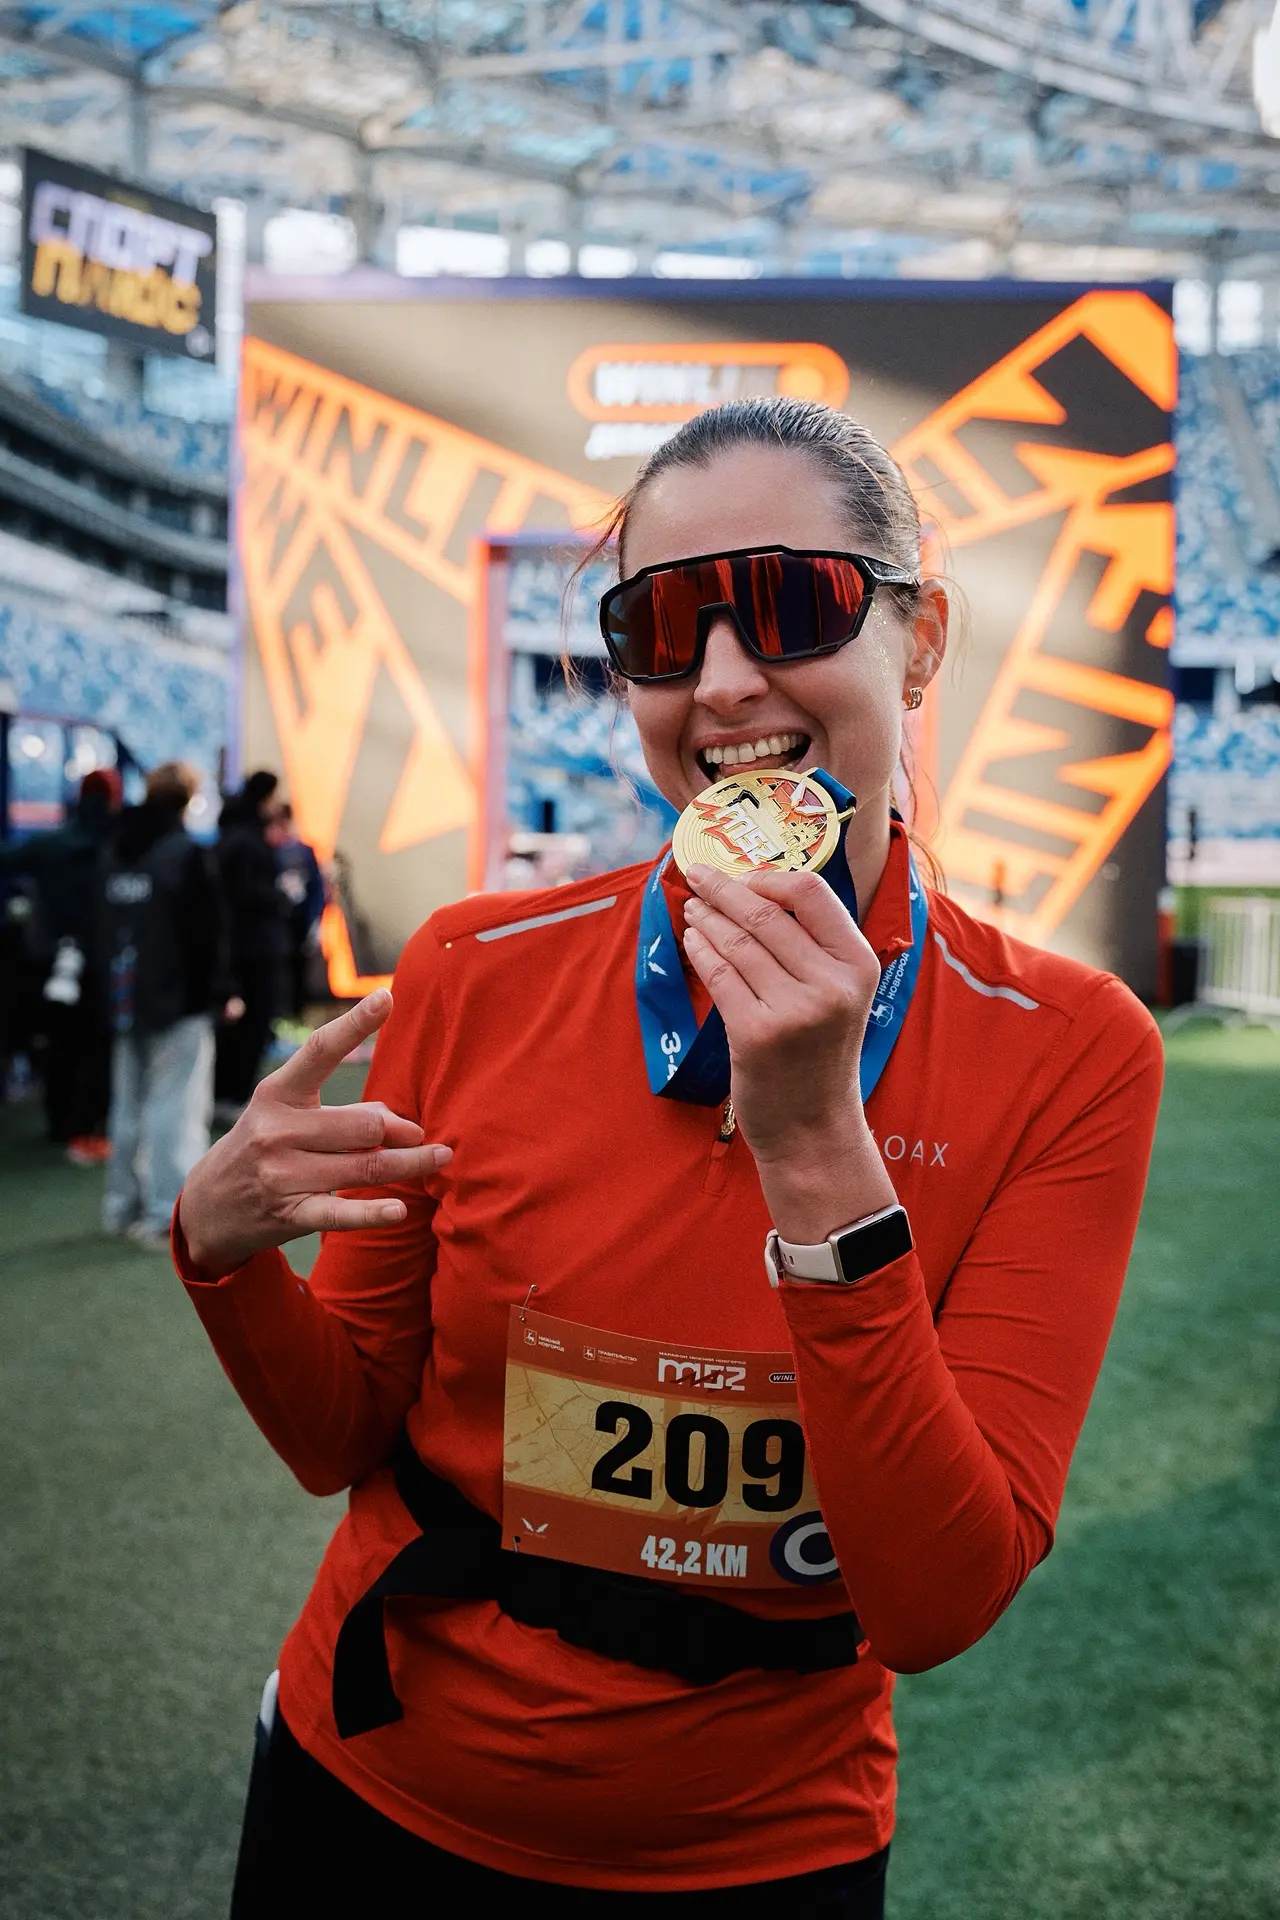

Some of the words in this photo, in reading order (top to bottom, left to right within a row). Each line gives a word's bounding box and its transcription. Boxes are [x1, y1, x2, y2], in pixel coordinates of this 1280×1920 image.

[877, 959, 897, 996] НИЖНИ
[886, 952, 910, 1000] НОВГОРОД
[884, 1135, 949, 1167] OAX
[591, 1400, 806, 1512] 209
